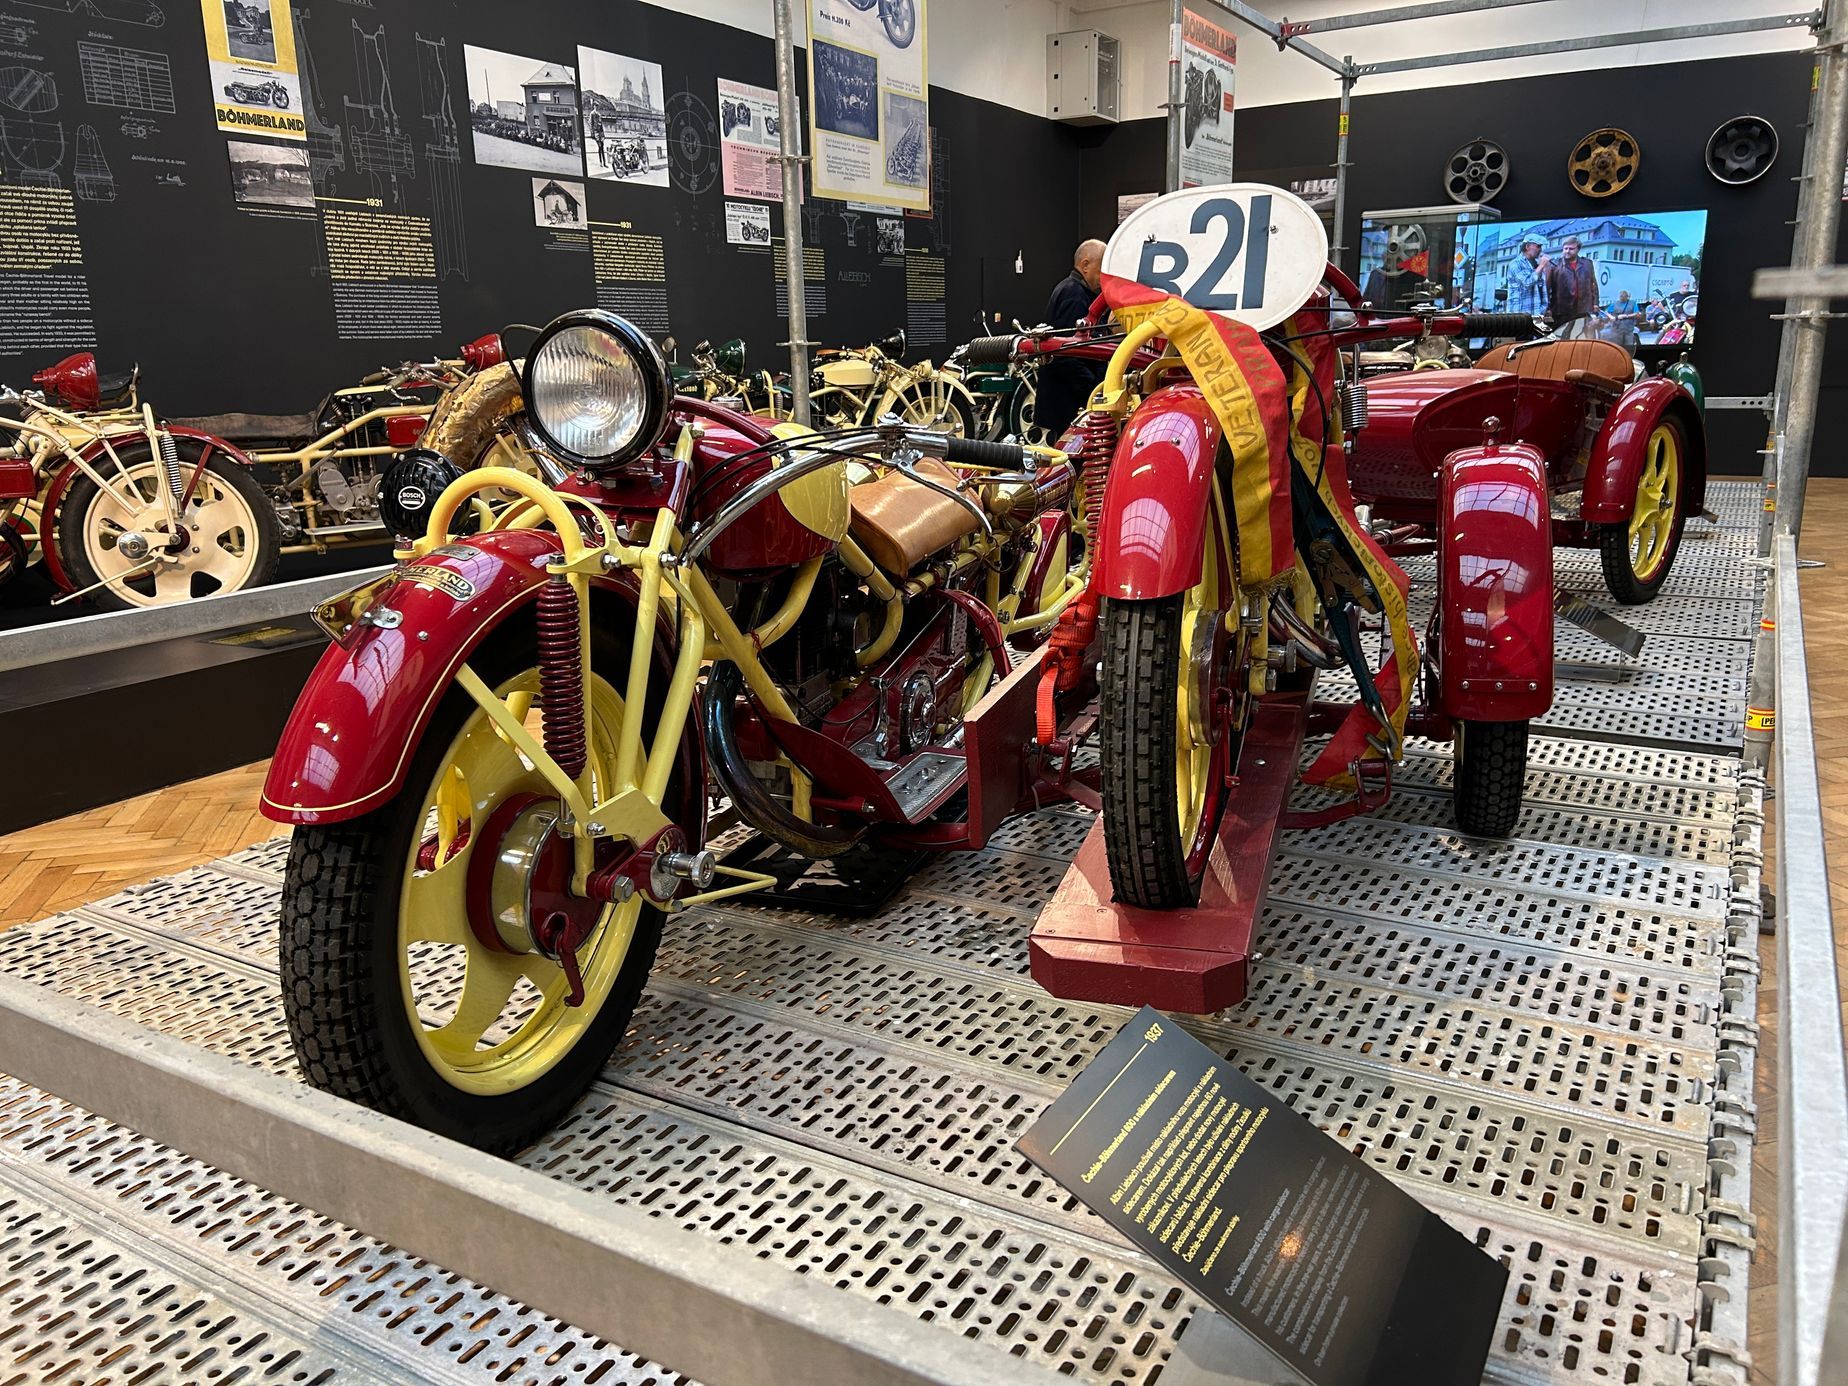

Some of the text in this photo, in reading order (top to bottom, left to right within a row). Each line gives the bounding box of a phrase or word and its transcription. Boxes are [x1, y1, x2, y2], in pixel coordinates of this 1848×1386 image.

[216, 108, 304, 132] BÖHMERLAND
[366, 198, 383, 207] 1931
[1191, 328, 1259, 451] VETERAN
[1144, 1023, 1163, 1043] 1937
[1081, 1129, 1128, 1183] Čechie-Böhmerland
[1123, 1118, 1136, 1132] 600
[1136, 1092, 1158, 1118] nákladním
[1154, 1070, 1176, 1095] sidecarem
[1110, 1189, 1124, 1205] Albin
[1119, 1169, 1139, 1191] Liebisch
[1136, 1149, 1153, 1172] používal
[1150, 1137, 1163, 1152] místo
[1184, 1086, 1200, 1107] motocykl
[1123, 1185, 1147, 1214] sidecarem.
[1142, 1163, 1161, 1186] Dokázal
[1156, 1156, 1167, 1167] tak
[1163, 1135, 1182, 1159] například
[1178, 1117, 1195, 1140] přepravit
[1191, 1099, 1209, 1120] najednou
[1210, 1082, 1221, 1095] nově
[1135, 1192, 1159, 1223] vyrobených
[1156, 1158, 1184, 1194] motocyklových
[1186, 1138, 1198, 1152] nebo
[1194, 1124, 1207, 1140] dodat
[1203, 1114, 1214, 1127] nový
[1210, 1096, 1227, 1117] motocykl
[1171, 1162, 1198, 1199] předválečných
[1193, 1148, 1208, 1164] letech
[1203, 1138, 1215, 1150] bylo
[1172, 1220, 1196, 1254] představuje
[1192, 1196, 1210, 1222] nákladní
[1206, 1180, 1221, 1200] sidecar
[1217, 1172, 1227, 1184] pro
[1223, 1152, 1240, 1175] přepravu
[1252, 1107, 1269, 1129] motocyklu
[1185, 1175, 1207, 1202] Vystavená
[1201, 1151, 1223, 1178] kombinace
[1228, 1124, 1242, 1140] rodiny
